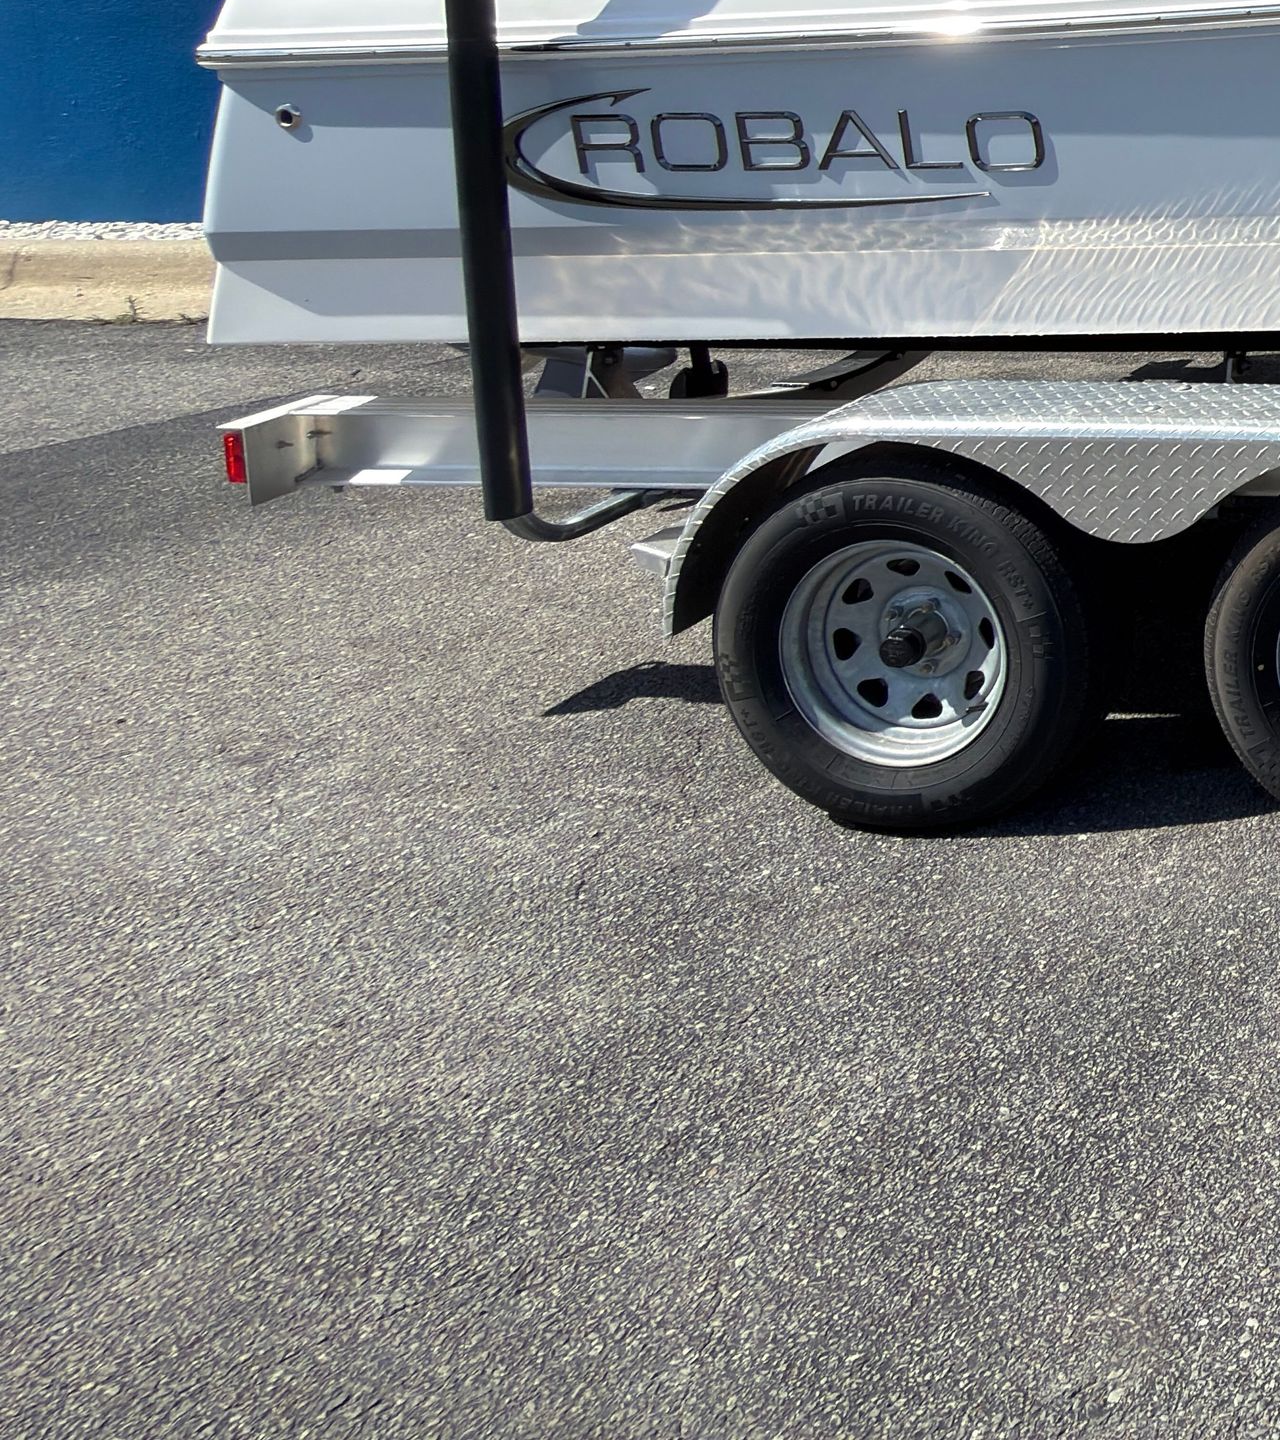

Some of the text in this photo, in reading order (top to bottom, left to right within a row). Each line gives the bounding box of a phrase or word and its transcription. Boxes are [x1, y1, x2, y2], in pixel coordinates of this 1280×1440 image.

[569, 108, 1045, 175] ROBALO
[852, 493, 944, 523] TRAILER
[949, 513, 998, 556] KING
[1223, 649, 1256, 740] TRAILER
